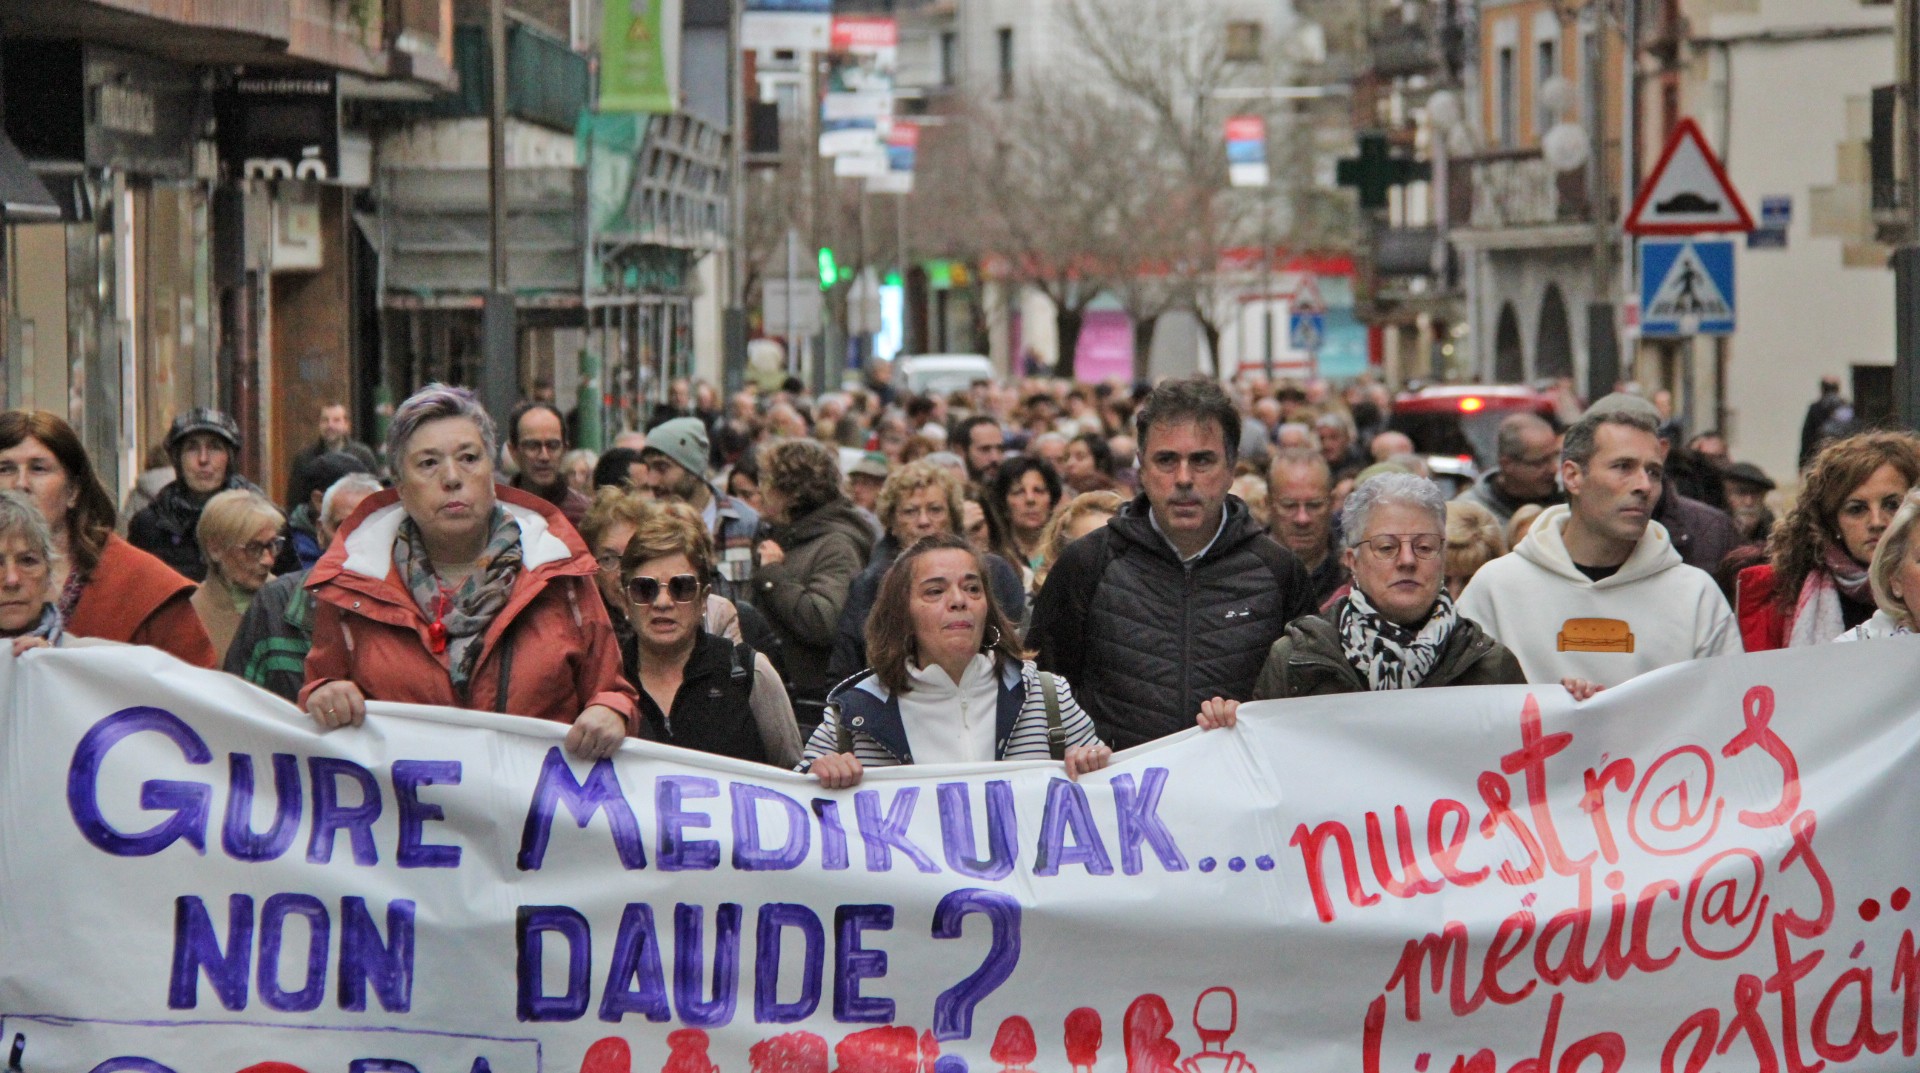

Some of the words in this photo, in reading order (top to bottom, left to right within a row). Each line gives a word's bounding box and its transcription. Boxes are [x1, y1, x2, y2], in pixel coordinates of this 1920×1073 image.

[67, 706, 462, 869] GURE
[1289, 685, 1801, 922] nuestr@s
[168, 893, 415, 1012] NON
[517, 888, 1022, 1073] DAUDE?
